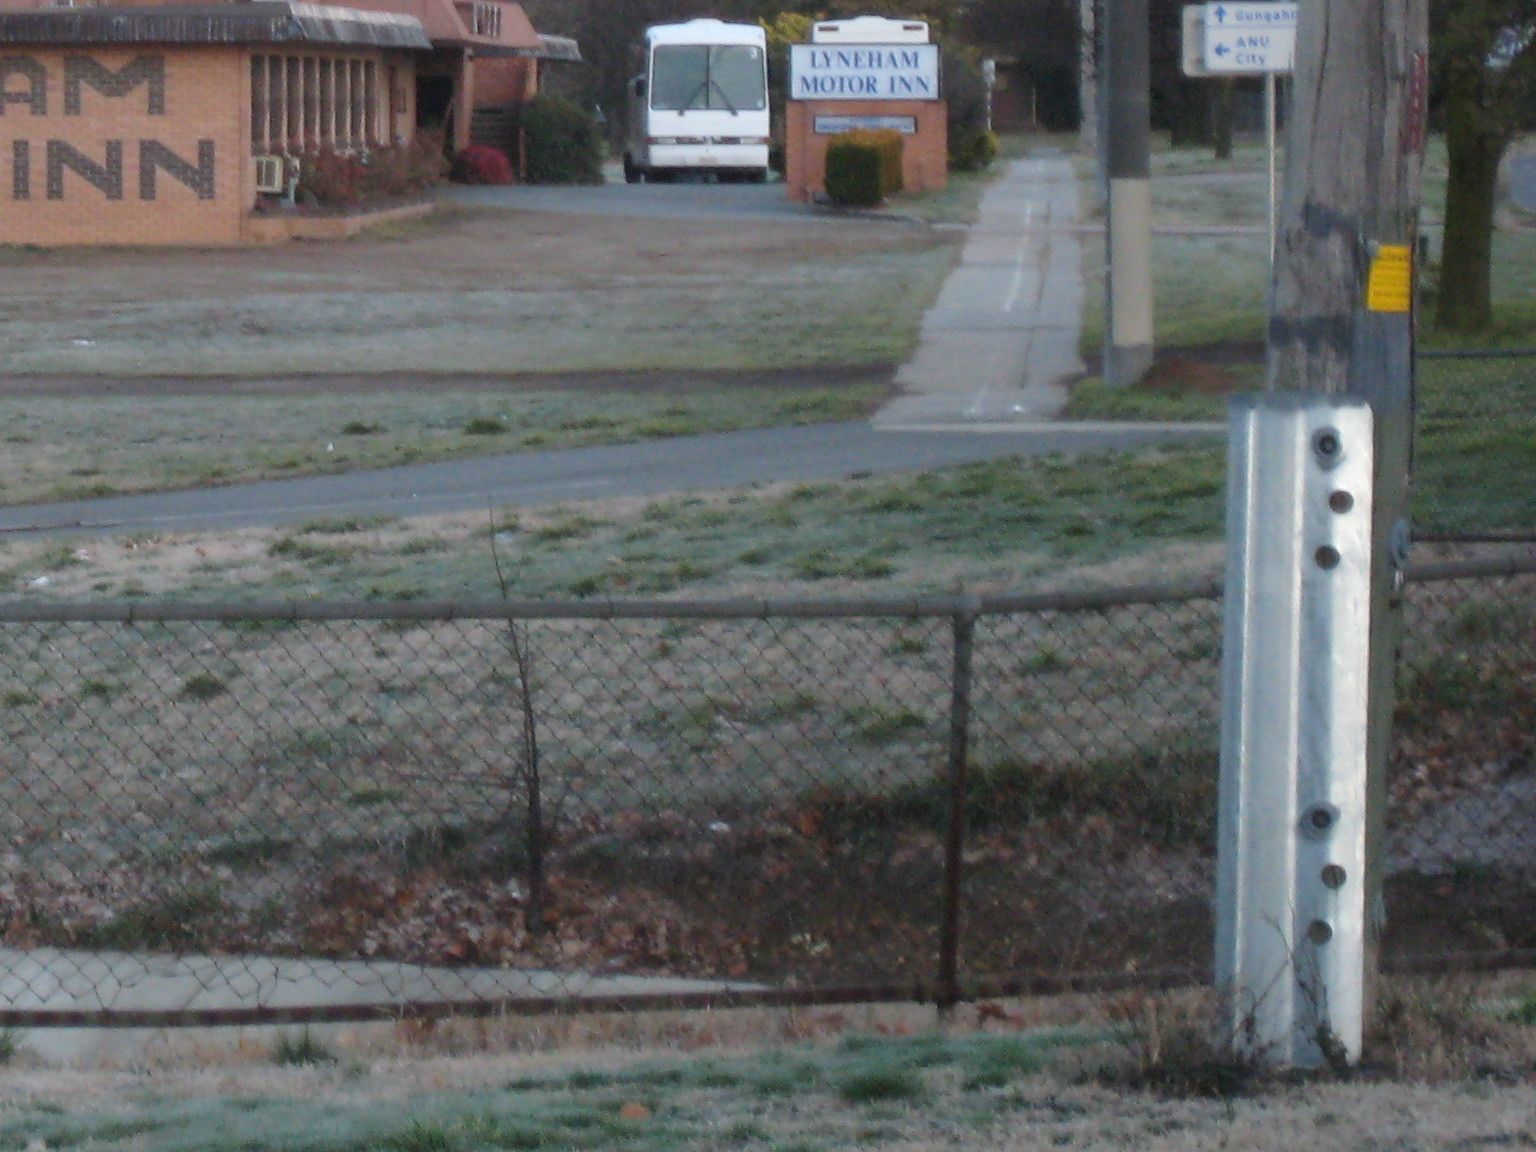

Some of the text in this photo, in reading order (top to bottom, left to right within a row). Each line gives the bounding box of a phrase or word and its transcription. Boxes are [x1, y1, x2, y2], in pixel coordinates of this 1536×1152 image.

[1237, 36, 1269, 48] ANU
[810, 51, 919, 68] LYNEHAM
[1236, 53, 1265, 65] City
[801, 76, 929, 93] MOTOR INN
[13, 139, 215, 201] INN
